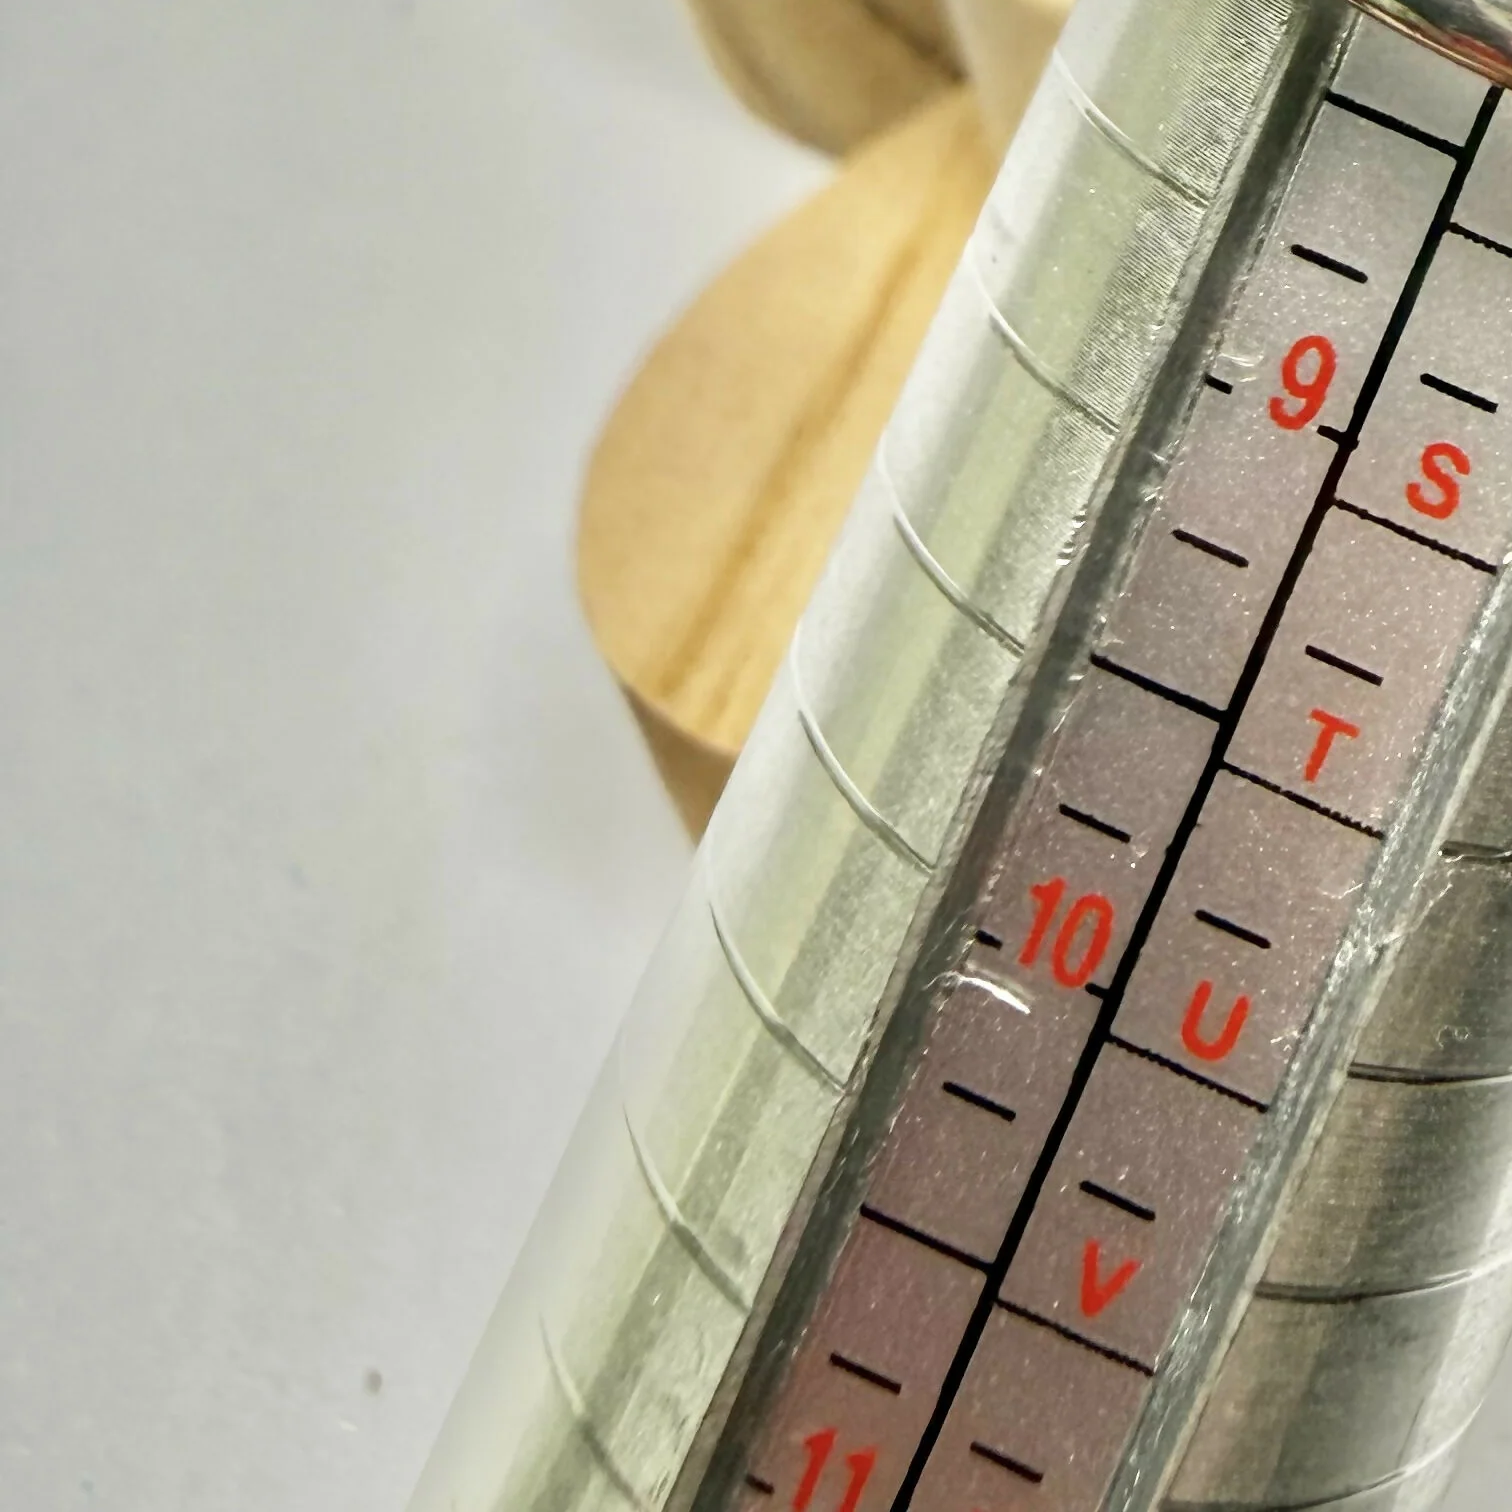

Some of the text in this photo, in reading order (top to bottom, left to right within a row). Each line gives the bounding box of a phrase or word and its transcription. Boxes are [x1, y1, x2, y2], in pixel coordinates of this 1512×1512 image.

[1267, 334, 1337, 432] 9
[1404, 441, 1472, 521] S
[1303, 707, 1361, 784] T
[1018, 875, 1116, 990] 10
[1179, 979, 1252, 1063] U
[1078, 1238, 1141, 1319] V
[790, 1425, 879, 1512] 11
